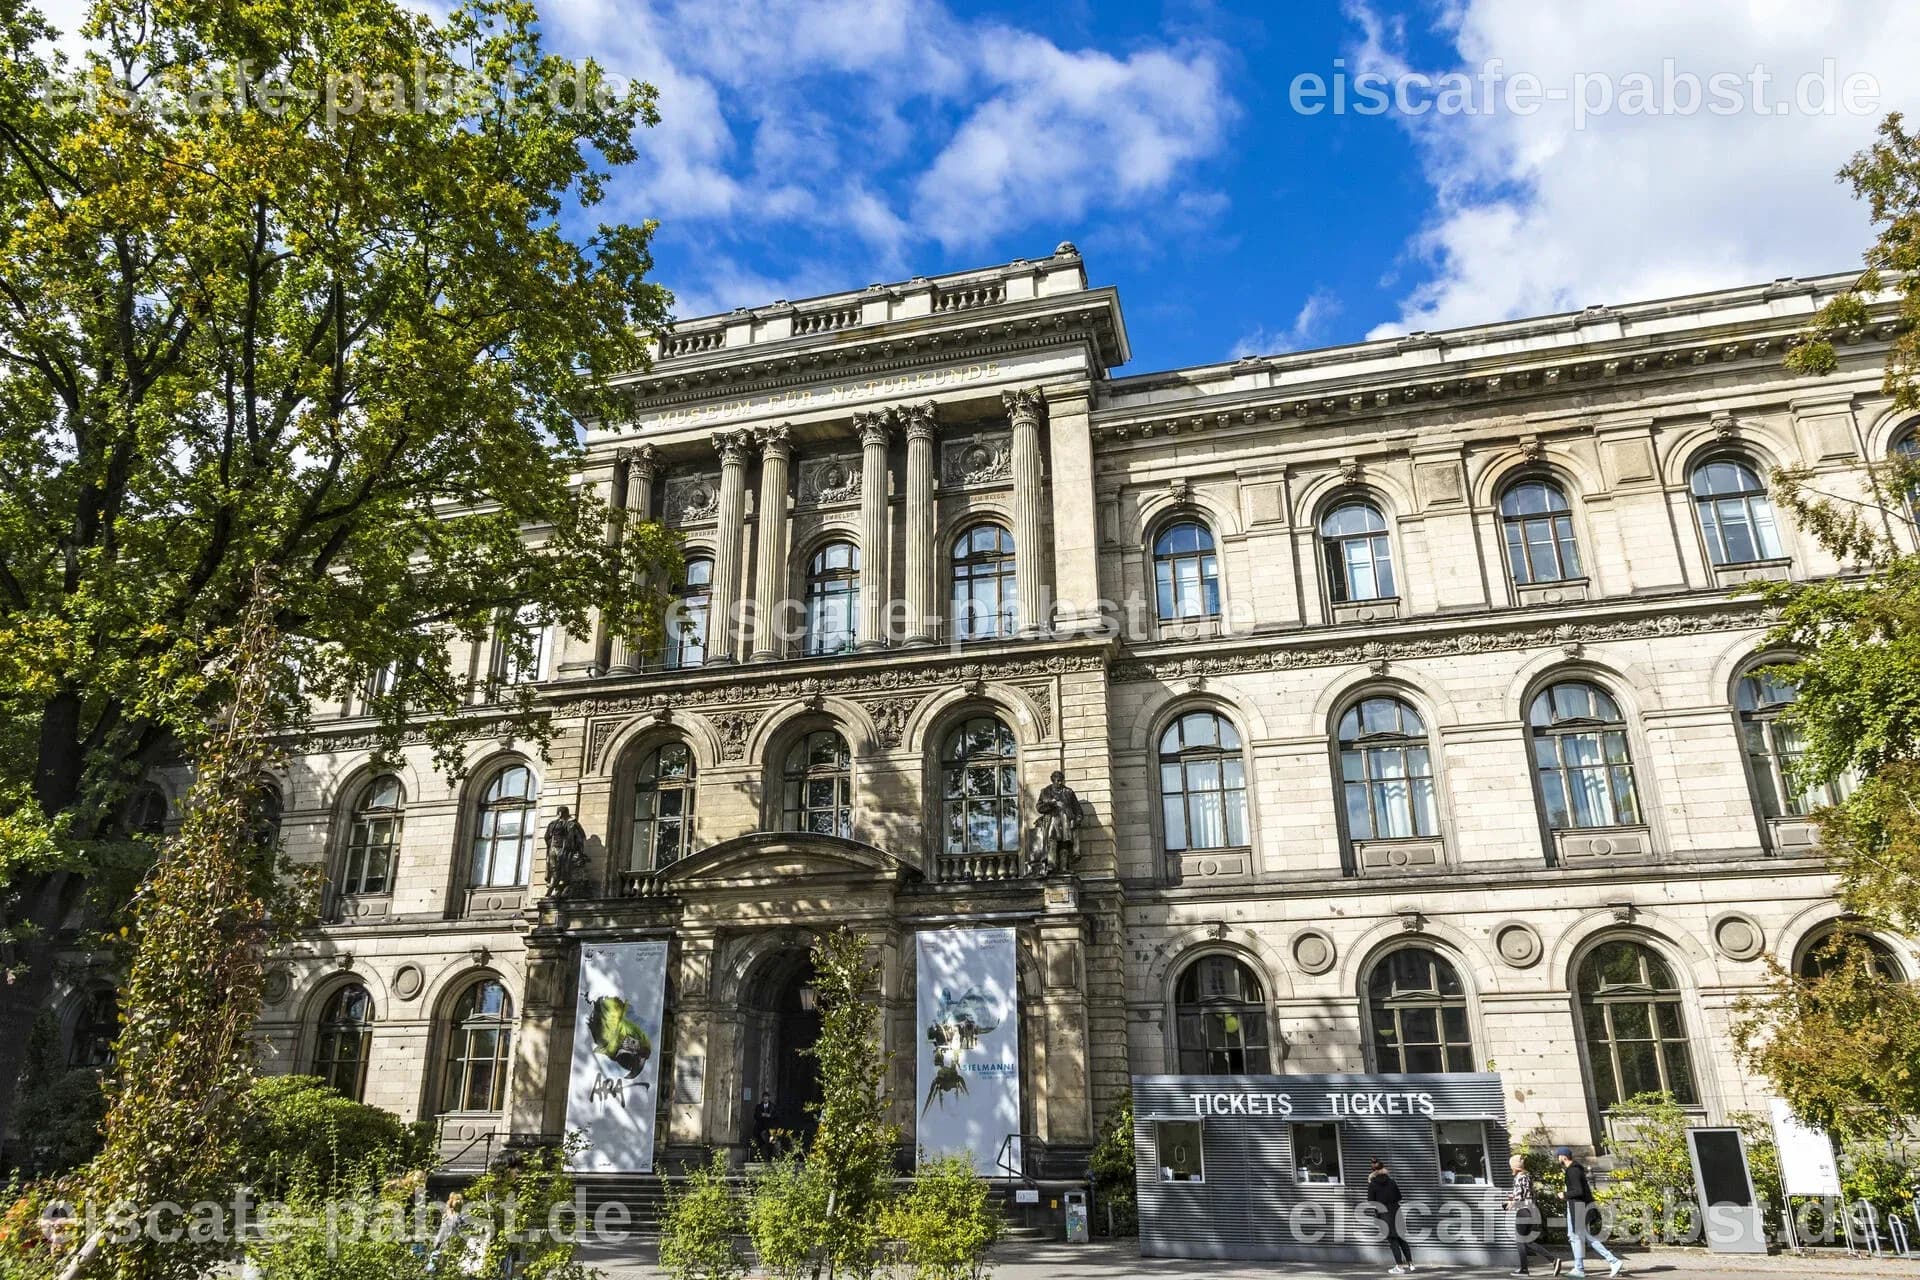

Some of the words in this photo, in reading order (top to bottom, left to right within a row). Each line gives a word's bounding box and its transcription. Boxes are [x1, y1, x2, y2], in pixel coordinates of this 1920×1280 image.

[657, 400, 752, 428] MUSEUM
[768, 390, 815, 411] FÜR
[831, 362, 1000, 402] NATURKUNDE
[589, 1072, 650, 1109] ARA
[1190, 1093, 1293, 1116] TICKETS
[1326, 1092, 1435, 1116] TICKETS
